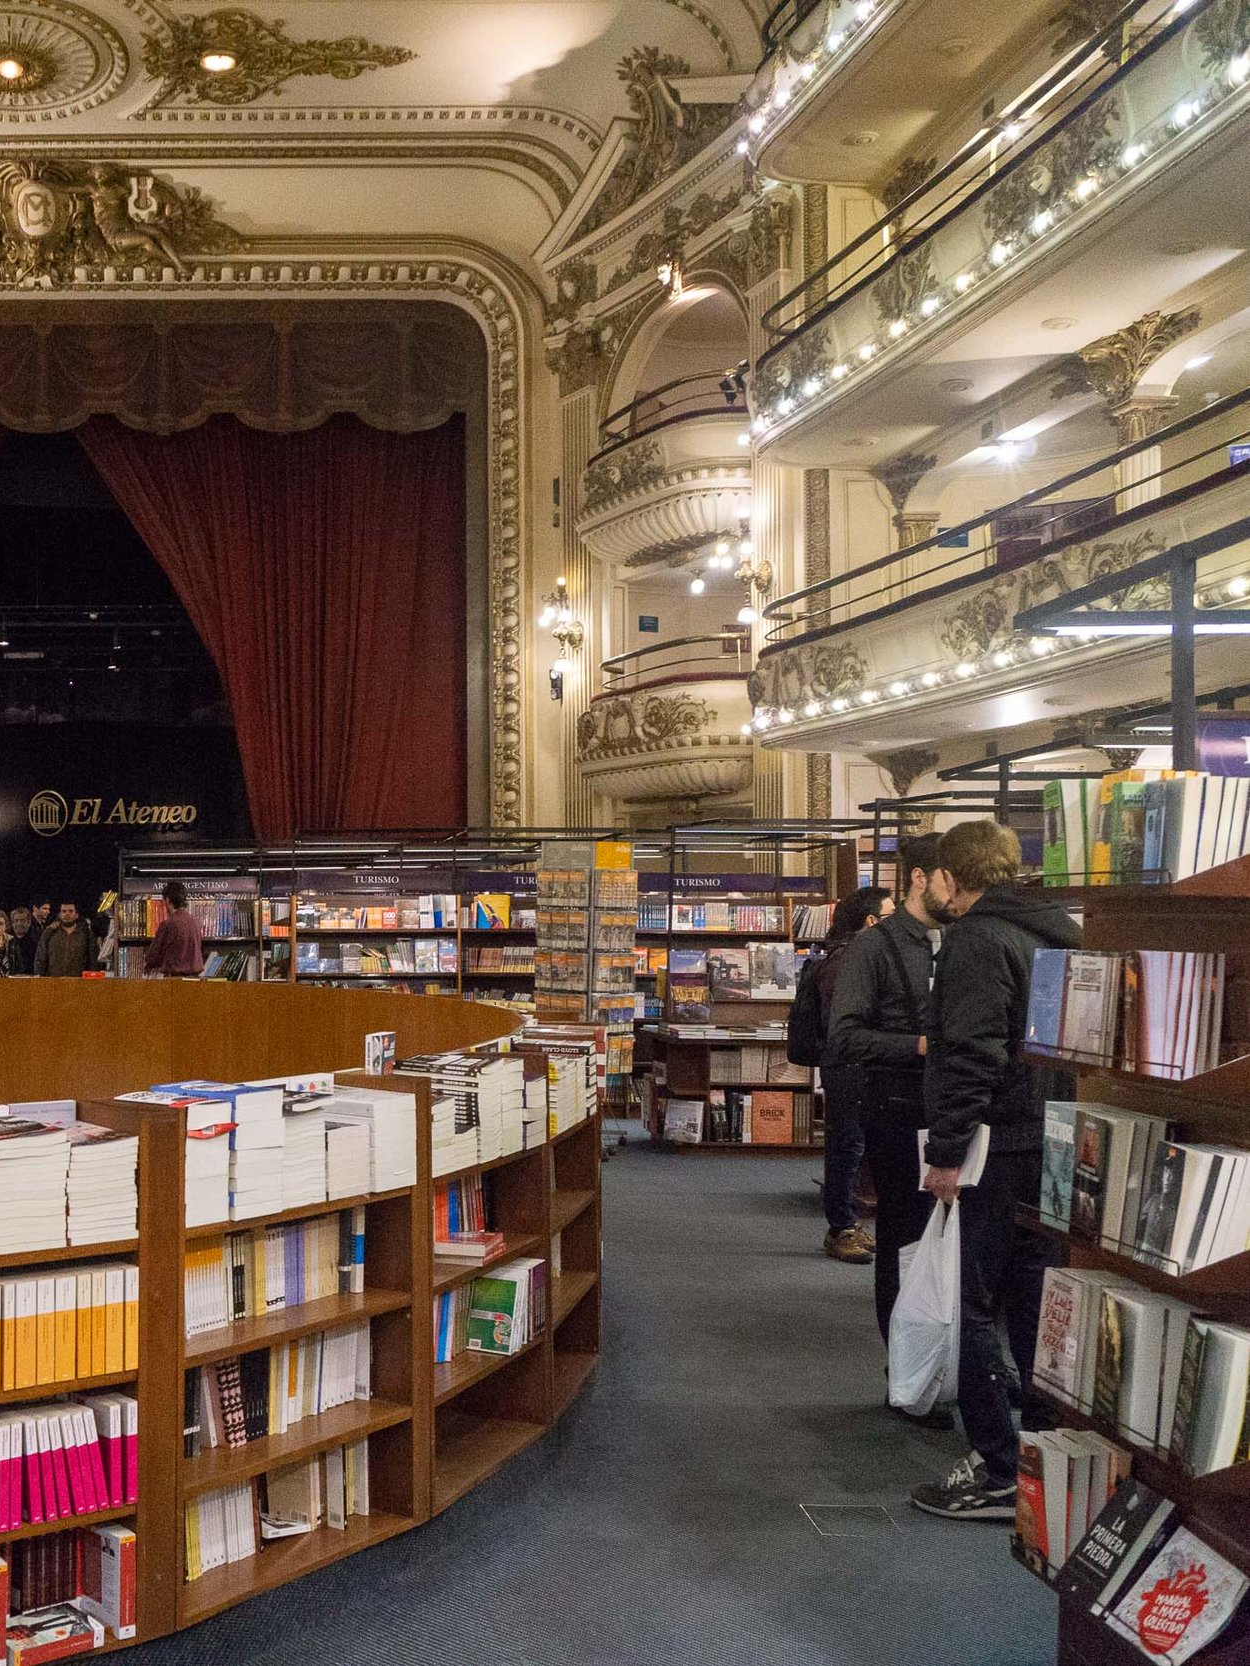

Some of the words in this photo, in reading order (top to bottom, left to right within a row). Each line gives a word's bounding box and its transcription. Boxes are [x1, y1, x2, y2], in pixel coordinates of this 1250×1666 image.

[69, 798, 102, 825] El
[104, 798, 197, 825] Ateneo
[182, 882, 229, 890] RGENTINO
[353, 875, 400, 885] TURISMO
[674, 877, 721, 887] TURISMO
[1111, 1516, 1124, 1533] LA
[1090, 1524, 1128, 1557] PRIMERA
[1083, 1540, 1116, 1570] PIEDRA
[1143, 1614, 1185, 1634] COLECTIVO
